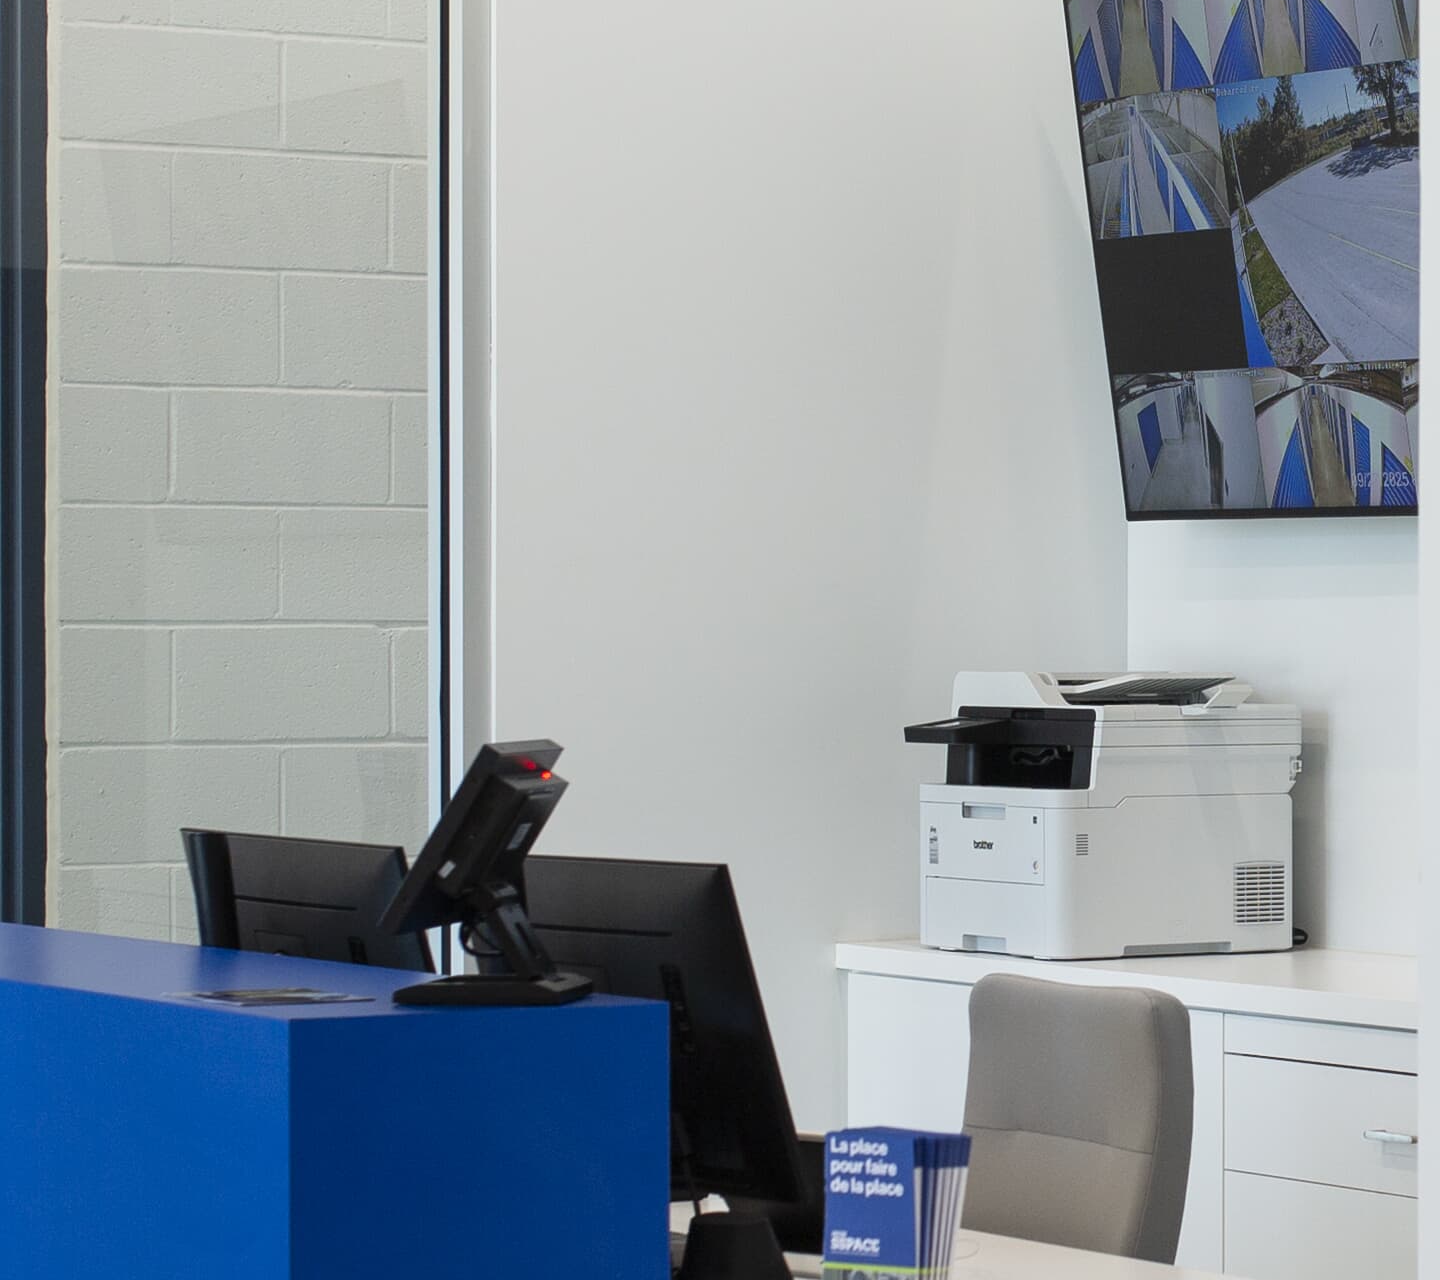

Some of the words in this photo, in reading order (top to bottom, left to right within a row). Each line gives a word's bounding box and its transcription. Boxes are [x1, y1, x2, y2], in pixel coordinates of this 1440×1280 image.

[830, 1136, 848, 1154] La
[849, 1137, 888, 1157] place
[830, 1159, 864, 1176] pour
[865, 1157, 898, 1176] faire
[830, 1176, 849, 1193] de
[850, 1177, 864, 1194] la
[865, 1178, 904, 1198] place
